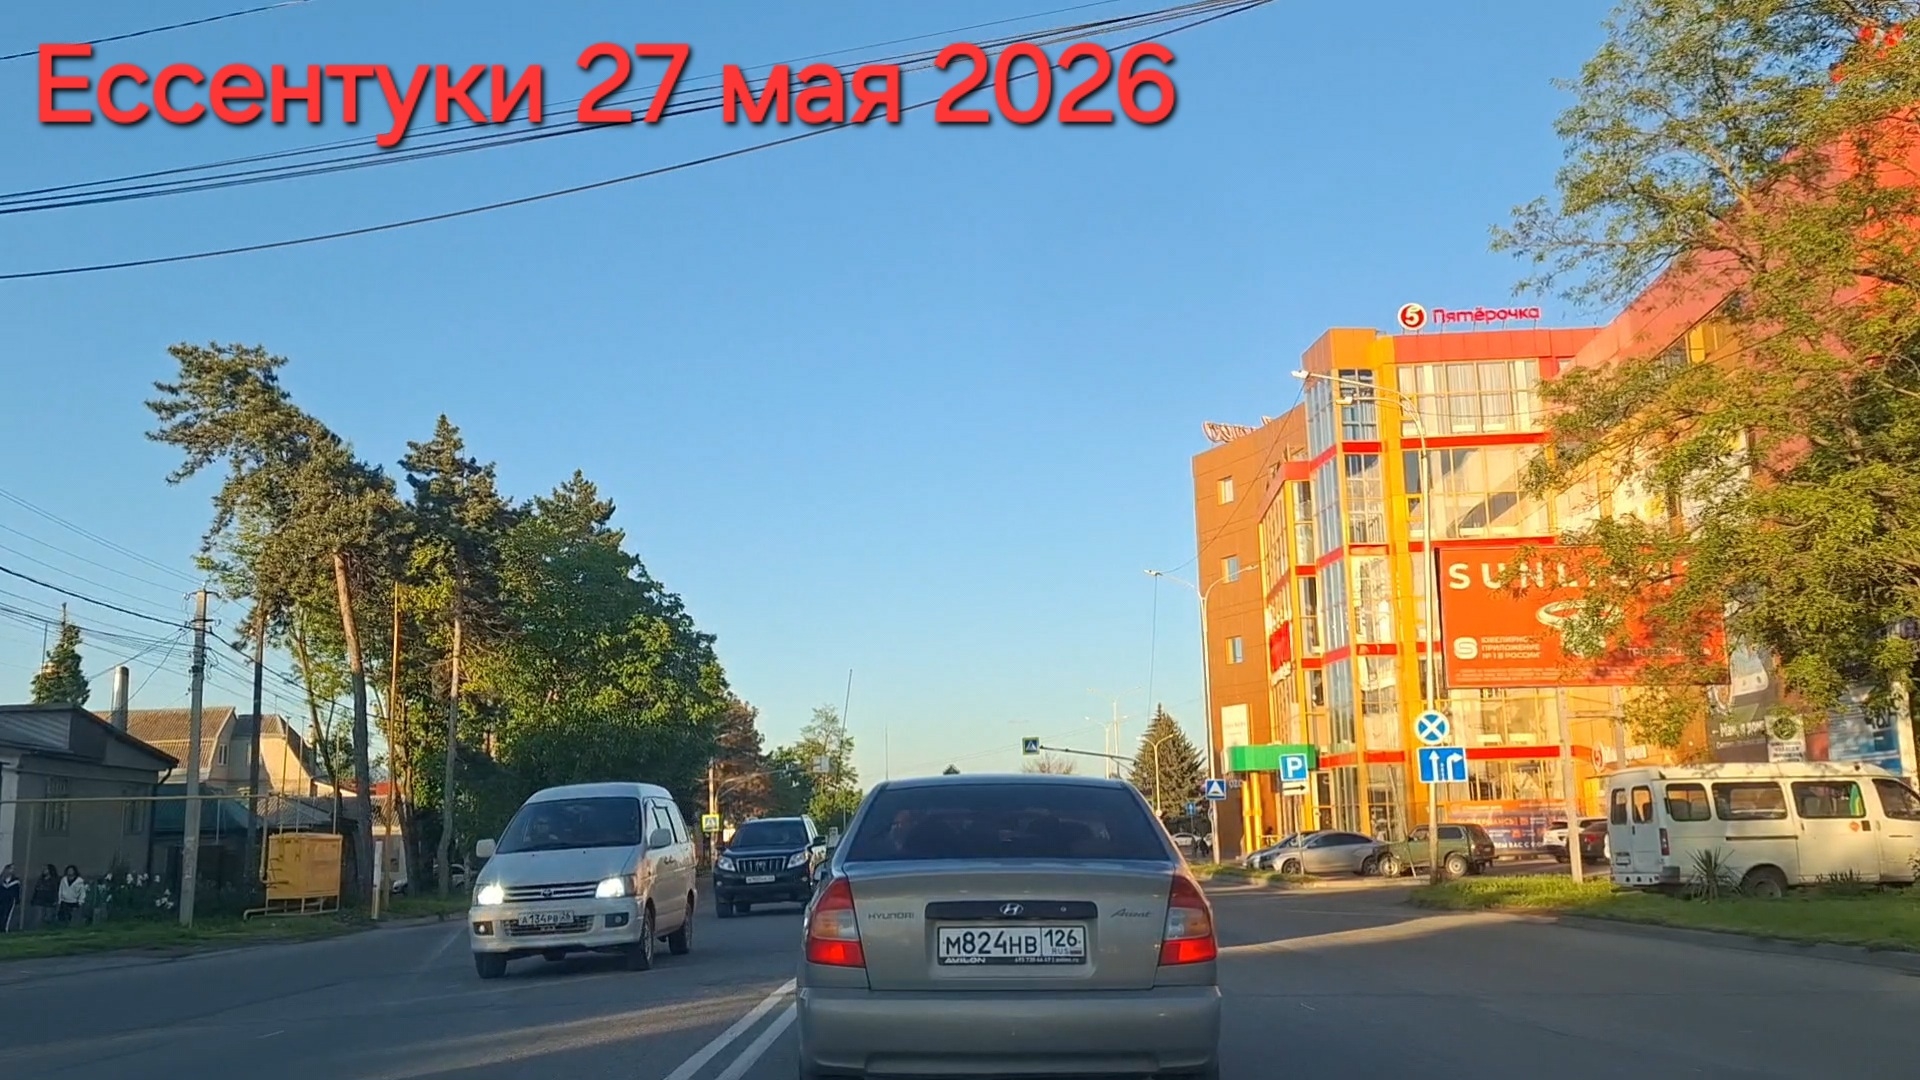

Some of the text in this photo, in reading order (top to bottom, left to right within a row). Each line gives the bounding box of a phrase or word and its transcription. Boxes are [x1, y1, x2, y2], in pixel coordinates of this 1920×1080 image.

[1433, 307, 1541, 324] Пятёрочка
[867, 911, 915, 920] HYUNDAI
[1044, 929, 1078, 948] 126
